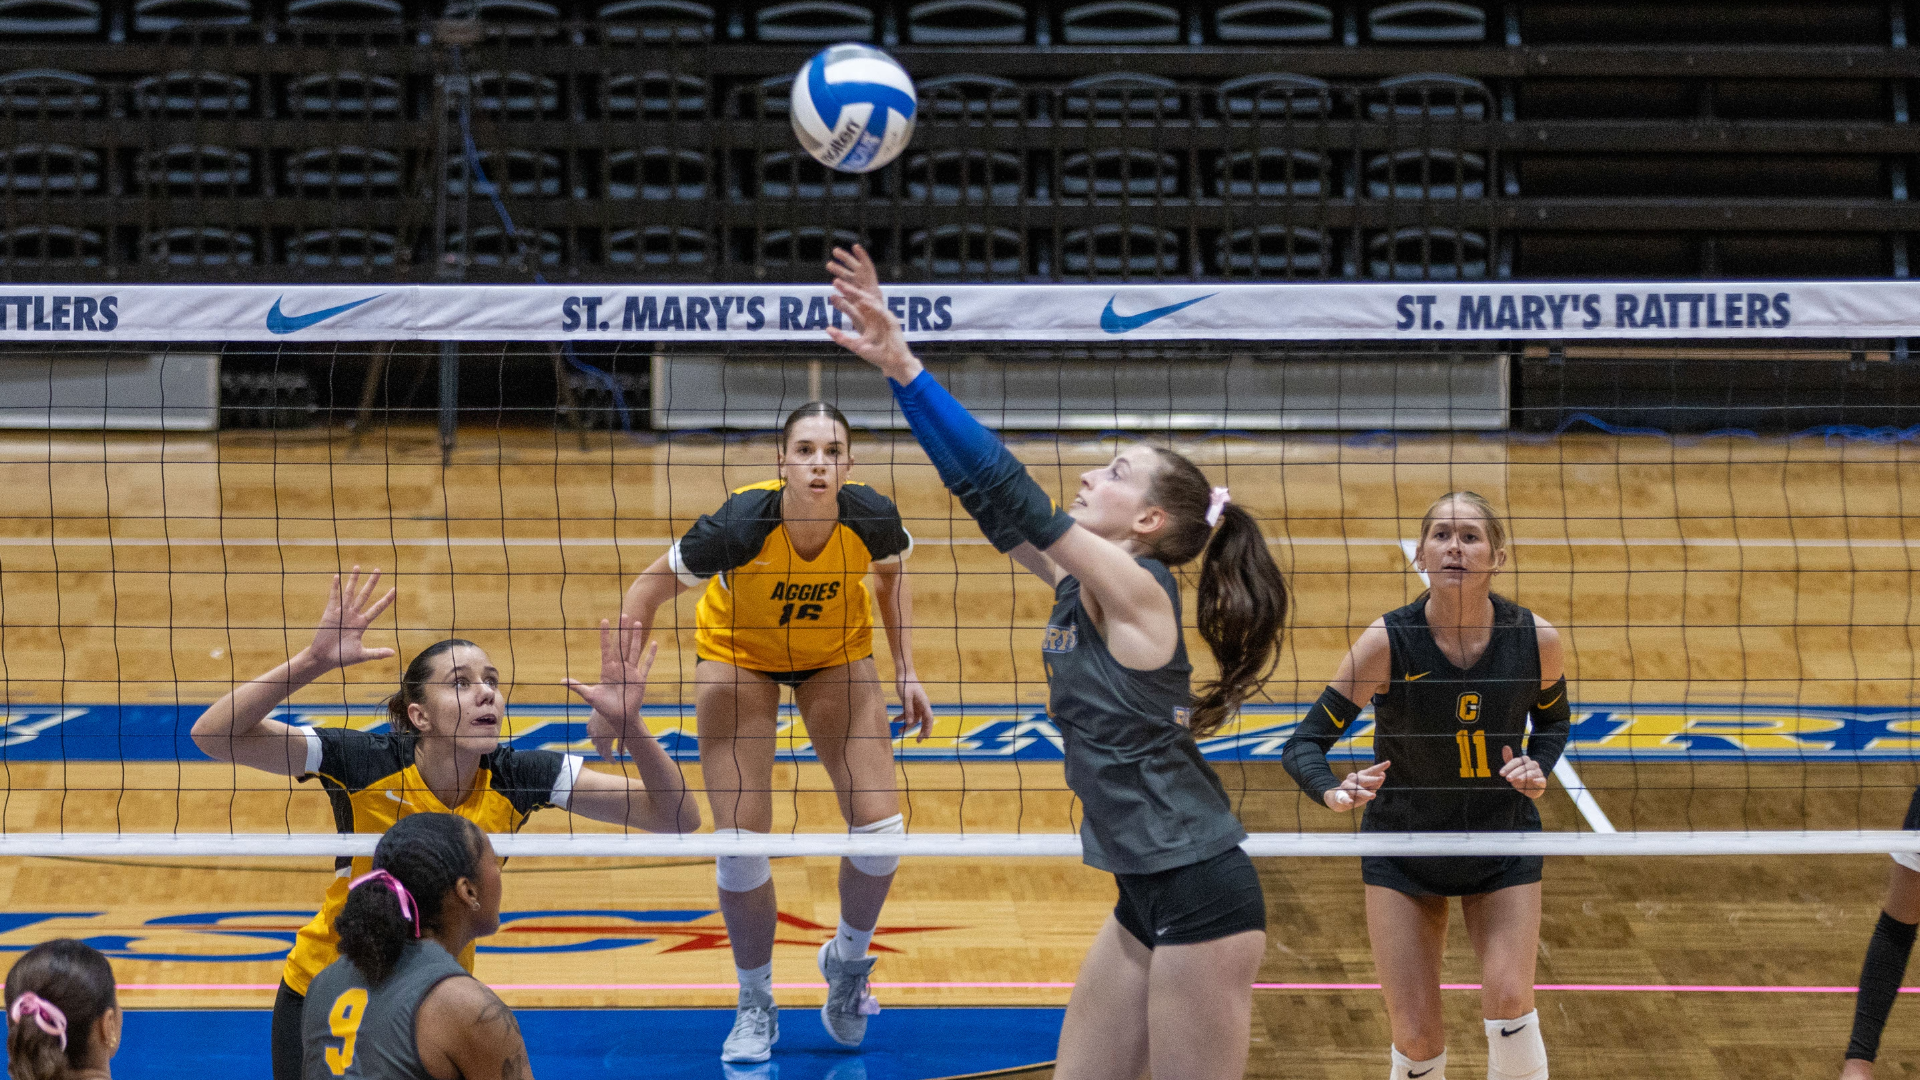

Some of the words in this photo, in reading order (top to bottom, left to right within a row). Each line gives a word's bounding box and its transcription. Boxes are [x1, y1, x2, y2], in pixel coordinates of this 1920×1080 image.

[562, 296, 610, 332] ST.
[622, 296, 766, 332] MARY'S
[779, 295, 953, 332] RATERS
[1396, 294, 1445, 331] ST.
[1457, 293, 1601, 331] MARY'S
[1615, 292, 1791, 329] RATTLERS
[770, 580, 840, 601] AGGIES
[779, 603, 823, 626] 16
[1456, 729, 1491, 777] 11
[325, 988, 369, 1076] 9
